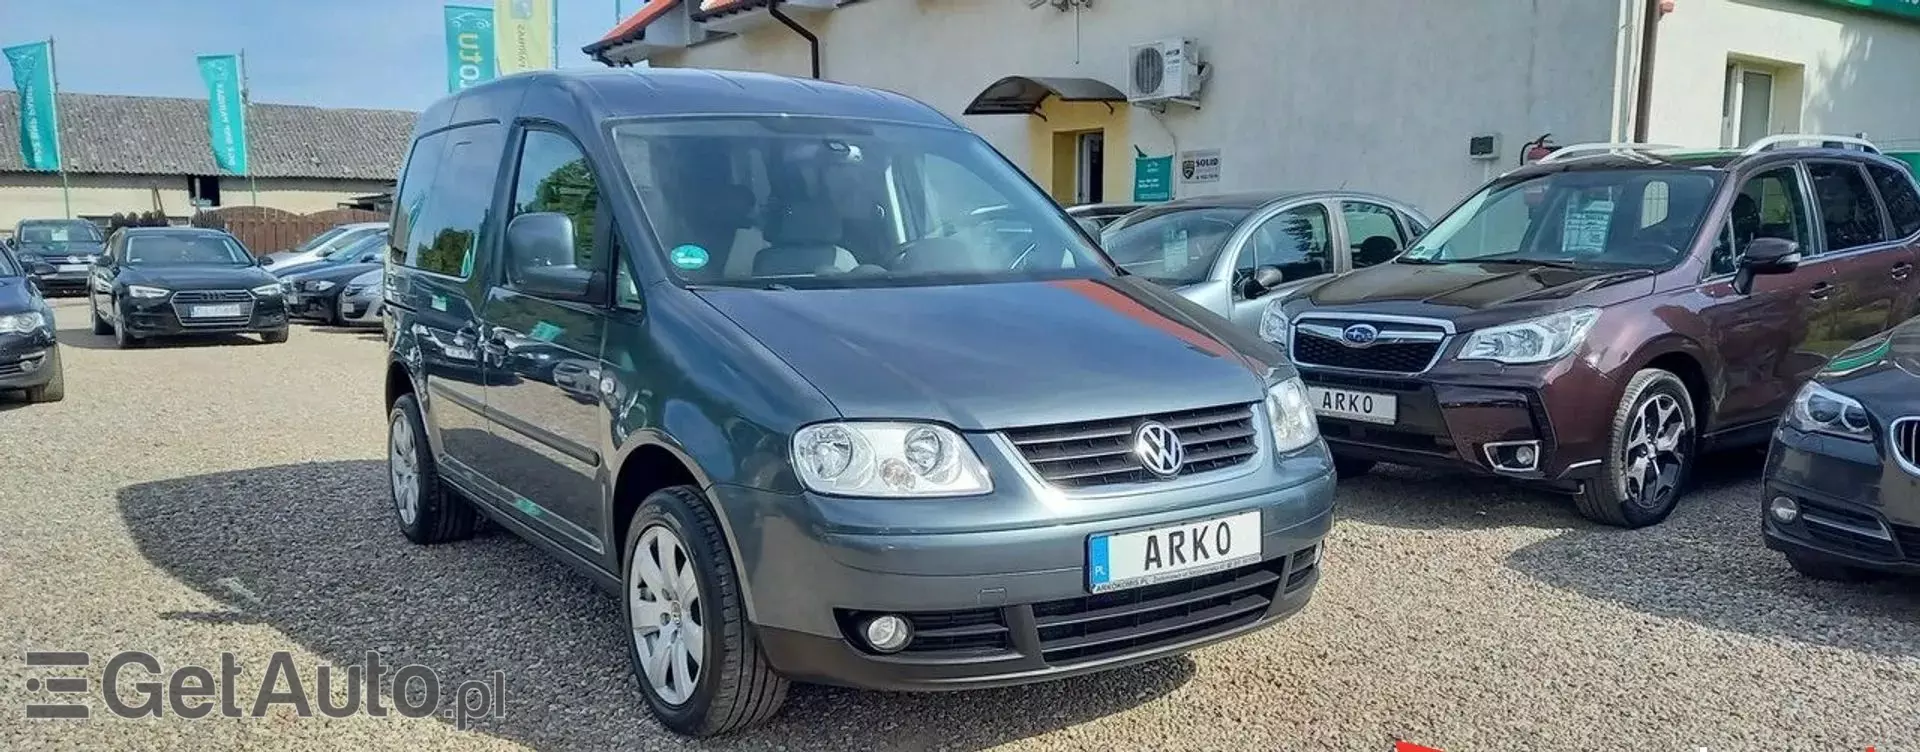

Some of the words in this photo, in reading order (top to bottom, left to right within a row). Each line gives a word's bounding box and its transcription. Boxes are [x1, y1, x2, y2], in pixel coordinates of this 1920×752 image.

[1195, 157, 1219, 168] SOLID
[1322, 391, 1374, 414] ARKO
[1144, 520, 1232, 571] ARKO
[1094, 565, 1107, 576] PL
